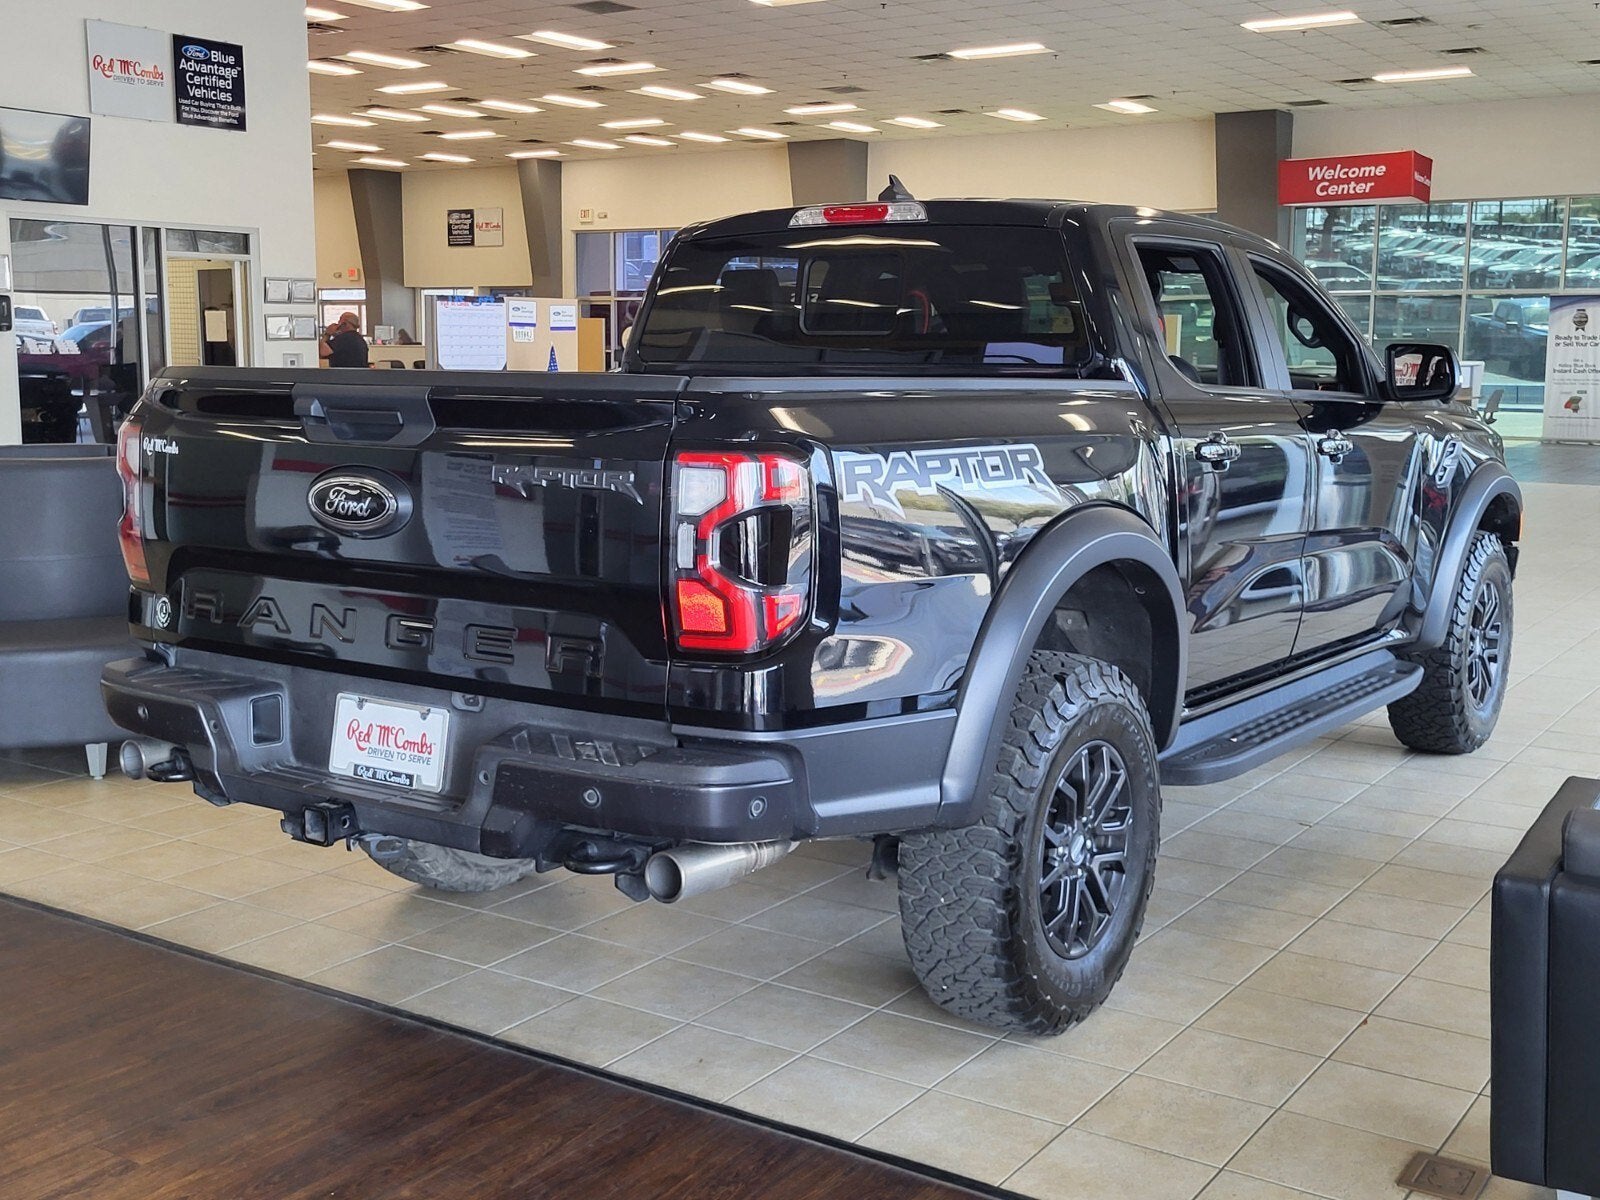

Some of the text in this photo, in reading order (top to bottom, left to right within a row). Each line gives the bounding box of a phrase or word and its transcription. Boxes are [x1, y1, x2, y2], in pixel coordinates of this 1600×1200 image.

[93, 54, 164, 80] Red McCombs
[211, 50, 235, 65] Blue
[113, 75, 164, 88] DRIVEN TO SERVE
[186, 72, 232, 90] Certified
[187, 84, 232, 102] Vehicles
[200, 100, 216, 109] Buying
[1307, 164, 1387, 181] Welcome
[1315, 181, 1375, 197] Center
[491, 464, 644, 506] RAPTOR
[839, 443, 1063, 518] RAPTOR
[324, 486, 372, 518] Ford
[185, 591, 605, 678] RANGER
[346, 718, 433, 755] Red McCombs
[367, 746, 432, 766] DRIVEN TO SERVE
[357, 765, 411, 786] Red McCombs
